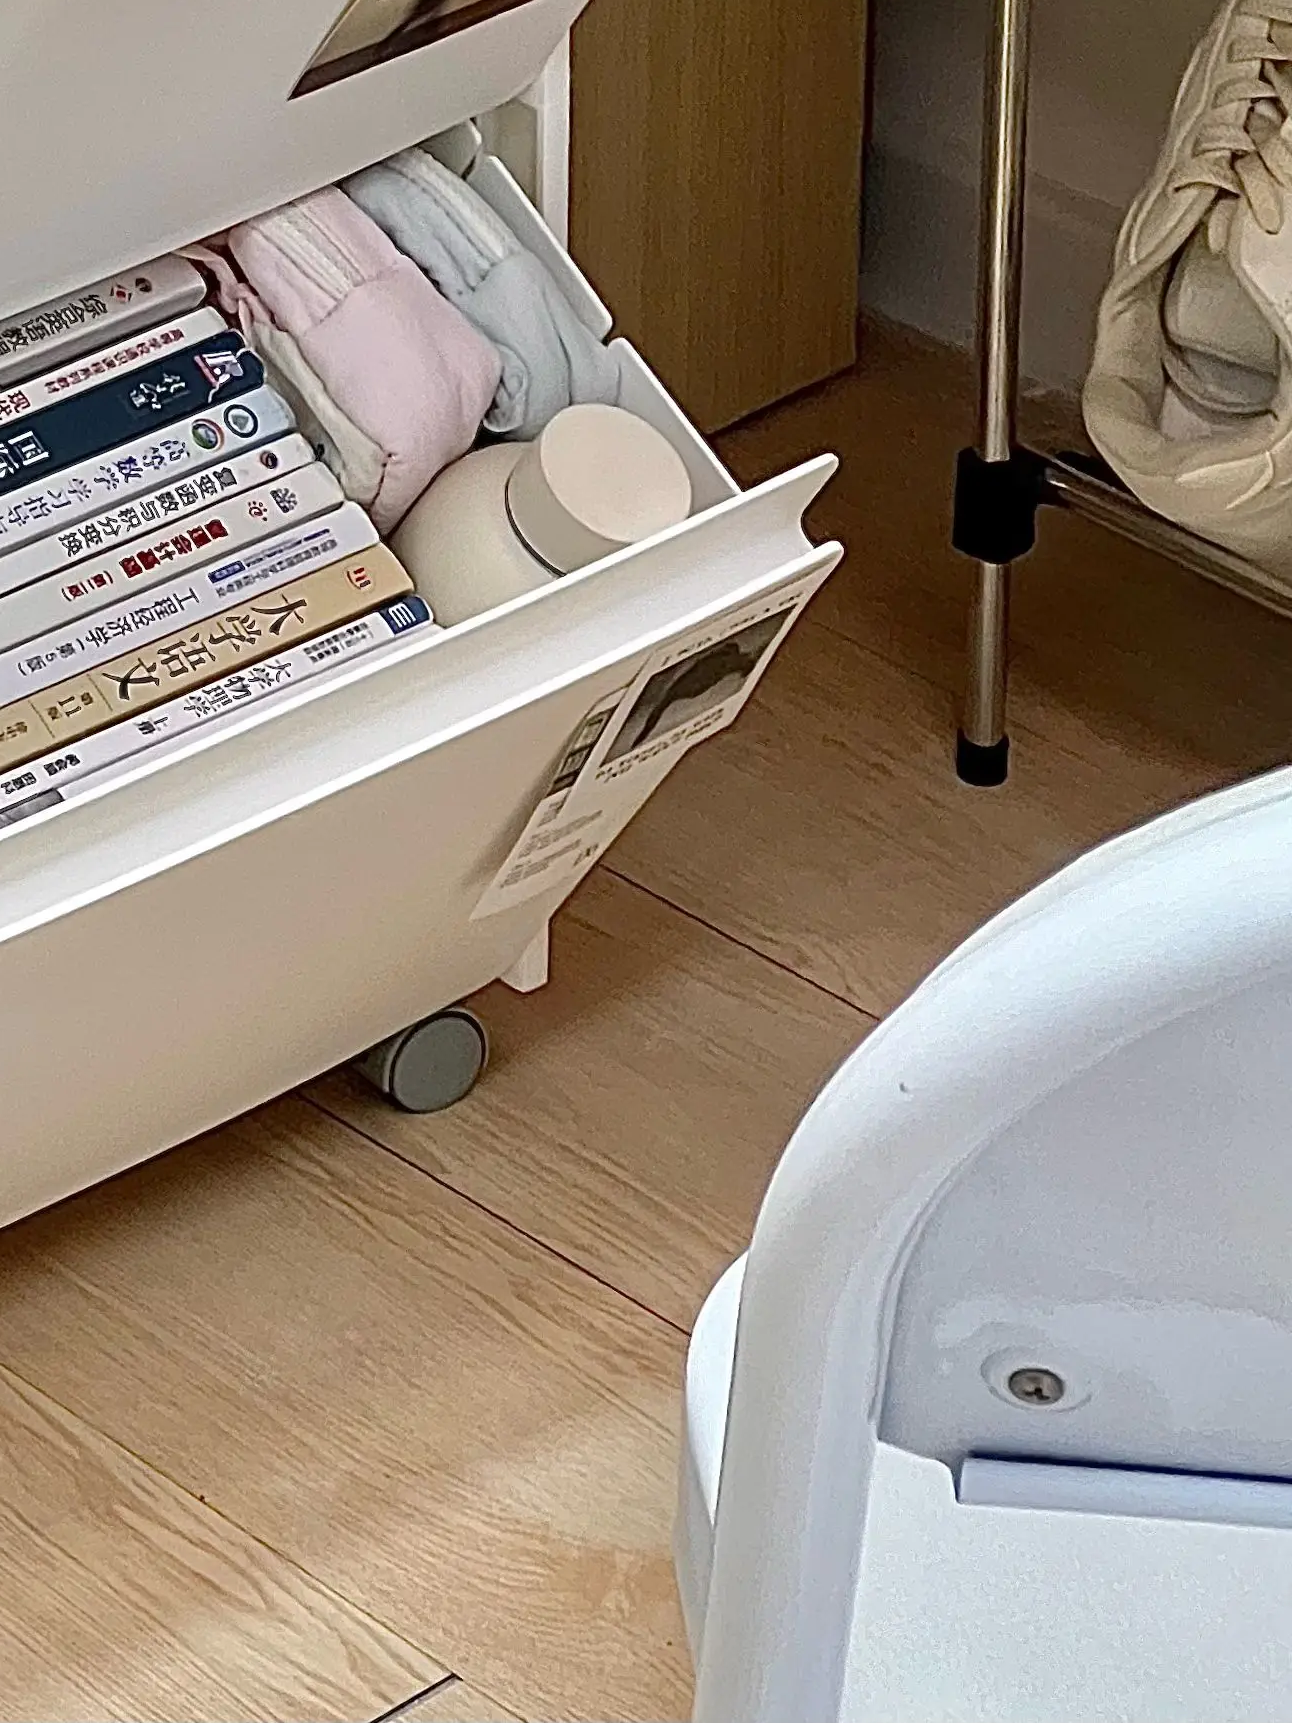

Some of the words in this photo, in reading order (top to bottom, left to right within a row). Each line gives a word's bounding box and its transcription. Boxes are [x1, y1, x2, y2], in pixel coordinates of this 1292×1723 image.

[88, 435, 192, 494] 高等数学
[56, 466, 239, 557] 复变函数与积分变换
[100, 588, 317, 703] 大学语文
[178, 655, 297, 720] 大学物理学
